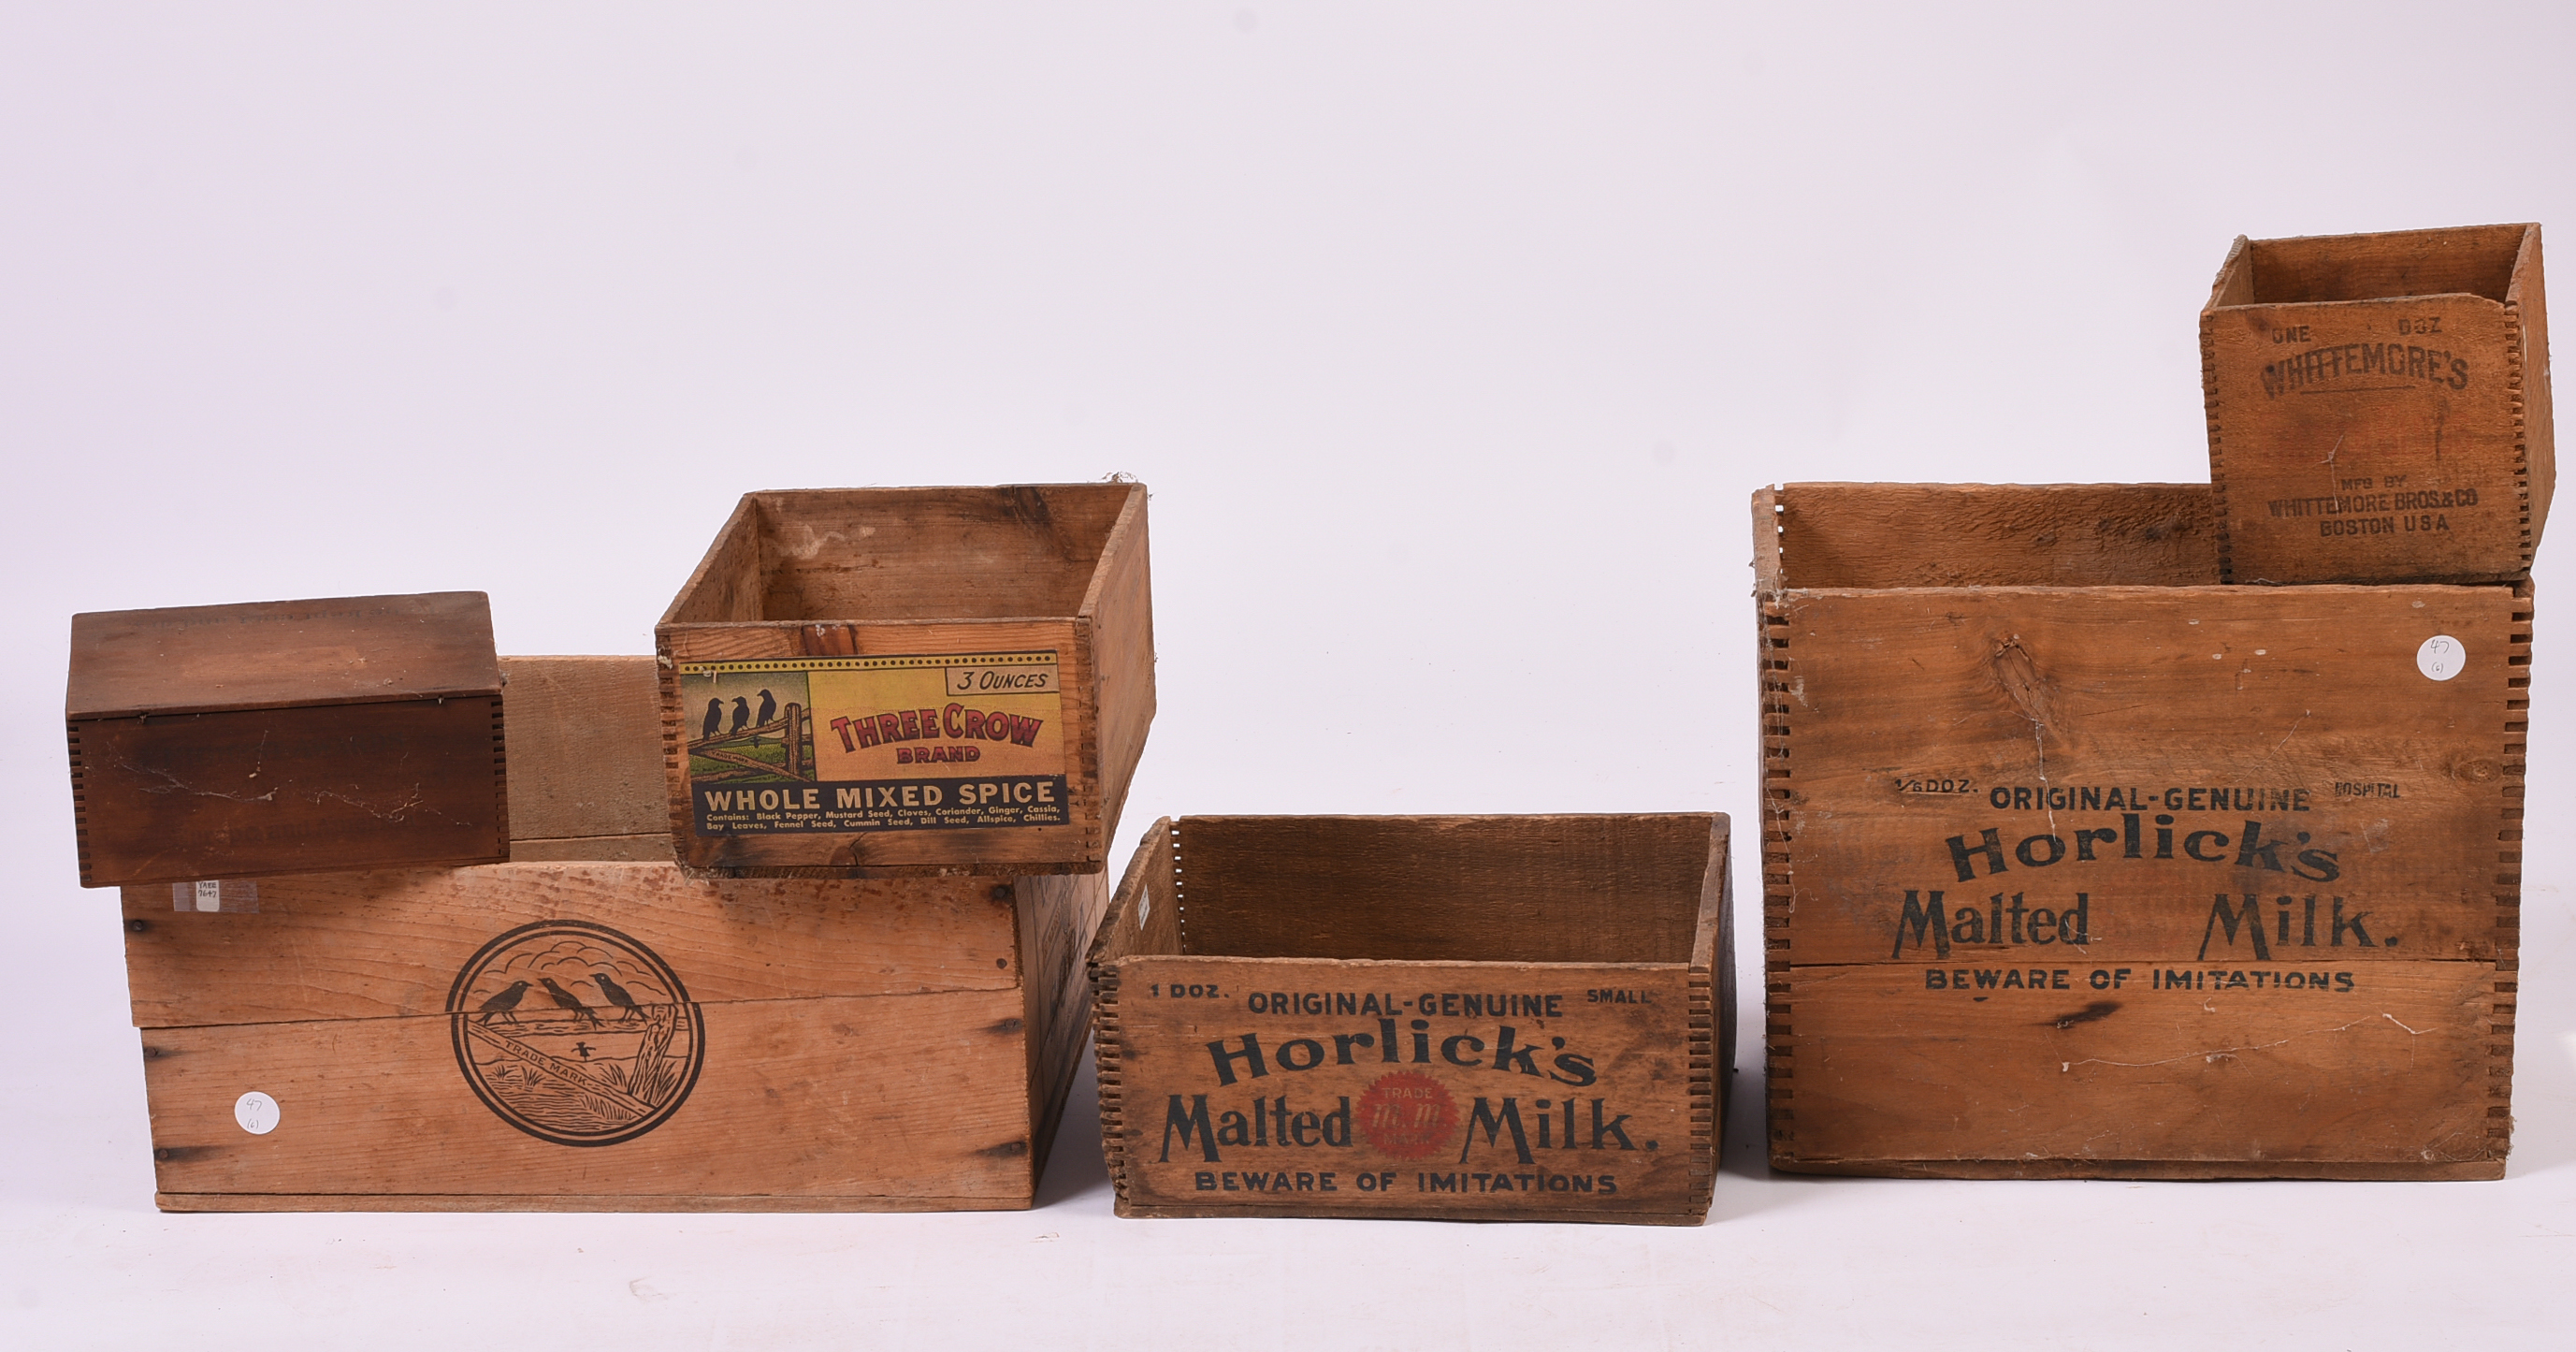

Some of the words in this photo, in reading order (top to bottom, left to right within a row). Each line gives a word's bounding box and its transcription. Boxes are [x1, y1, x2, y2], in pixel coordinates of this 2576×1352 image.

[2272, 326, 2311, 343] ONE
[2260, 342, 2468, 400] WHITTEMORE'S
[2384, 474, 2407, 487] BY
[2267, 494, 2392, 517] WHITTEMORE
[2320, 517, 2395, 537] BOSTON
[2431, 639, 2449, 654] 47
[957, 672, 973, 691] 3
[979, 670, 1049, 690] OUNCES
[830, 707, 940, 754] THREE
[941, 702, 1044, 748] CROW
[896, 745, 980, 764] BRAND
[704, 788, 820, 812] WHOLE
[836, 785, 943, 809] MIXED
[959, 780, 1056, 805] SPICE
[1990, 786, 2311, 812] ORIGINAL-GENUINE
[706, 813, 750, 821] Contains:
[757, 812, 781, 821] Black
[786, 811, 821, 821] Pepper,
[825, 810, 863, 819] Mustard
[868, 809, 893, 819] Seed,
[897, 808, 932, 817] Cloves,
[935, 807, 984, 817] Coriander,
[989, 806, 1023, 815] Ginger,
[1027, 805, 1060, 814] Cassia,
[706, 821, 725, 832] Bay
[732, 821, 768, 830] Leaves,
[774, 821, 804, 829] Fennel
[811, 820, 836, 829] Seed,
[844, 819, 880, 827] Cummin
[888, 817, 913, 826] Seed,
[920, 816, 936, 824] Dill
[944, 815, 969, 824] Seed,
[977, 814, 1016, 823] Allspice,
[1023, 813, 1061, 822] Chillies.
[1946, 813, 2340, 882] Horlick's
[1891, 890, 2091, 960] Malted
[2197, 893, 2399, 961] Milk.
[1151, 983, 1159, 997] 1
[1170, 983, 1229, 998] DOZ.
[1925, 967, 2071, 990] BEWARE
[2089, 967, 2132, 990] OF
[2152, 968, 2356, 993] IMITATIONS
[1248, 991, 1563, 1018] ORIGINAL-GENUINE
[1586, 989, 1652, 1004] SMALL
[504, 1039, 545, 1066] TRADE
[549, 1062, 587, 1084] MARK
[1206, 1017, 1599, 1087] Horlick's
[1382, 1087, 1434, 1099] TRADE
[246, 1098, 262, 1112] 47
[1158, 1093, 1353, 1164] Malted
[1458, 1096, 1659, 1166] Milk.
[1194, 1171, 1338, 1192] BEWARE
[1355, 1171, 1397, 1192] OF
[1417, 1171, 1618, 1195] IMITATIONS
